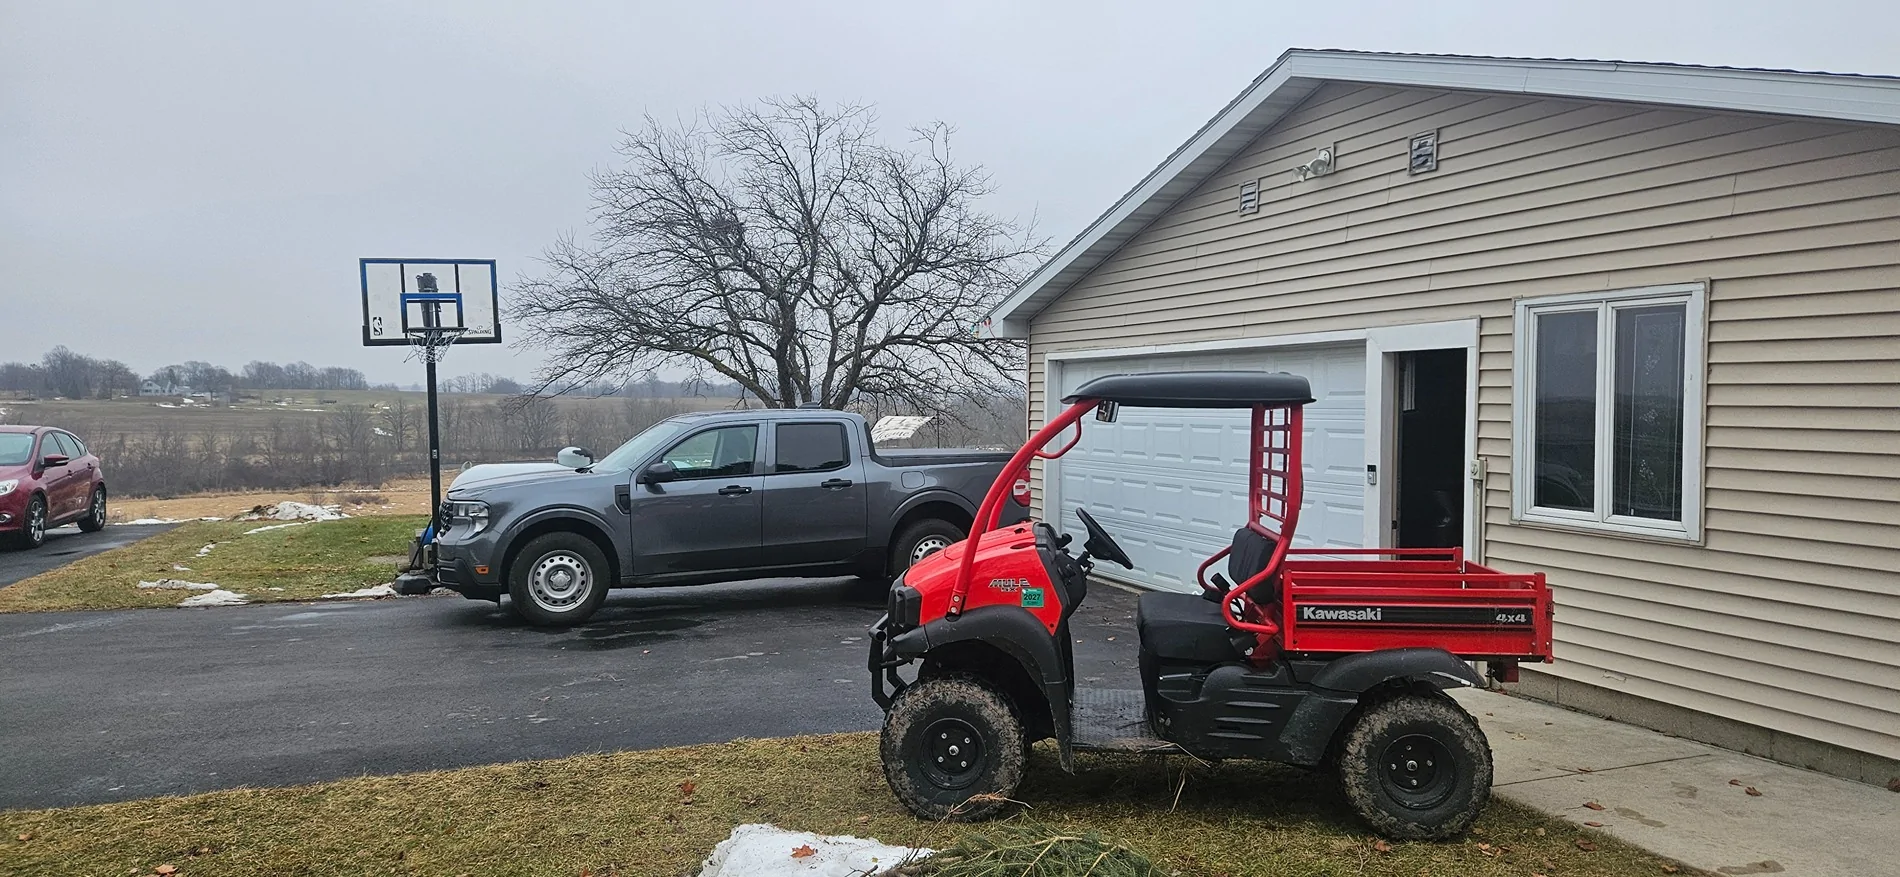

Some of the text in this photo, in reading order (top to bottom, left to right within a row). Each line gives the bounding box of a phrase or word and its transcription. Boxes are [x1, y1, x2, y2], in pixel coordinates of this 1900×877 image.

[988, 578, 1031, 588] MULE
[1303, 606, 1381, 620] Kawasaki
[1495, 613, 1526, 622] 4x4
